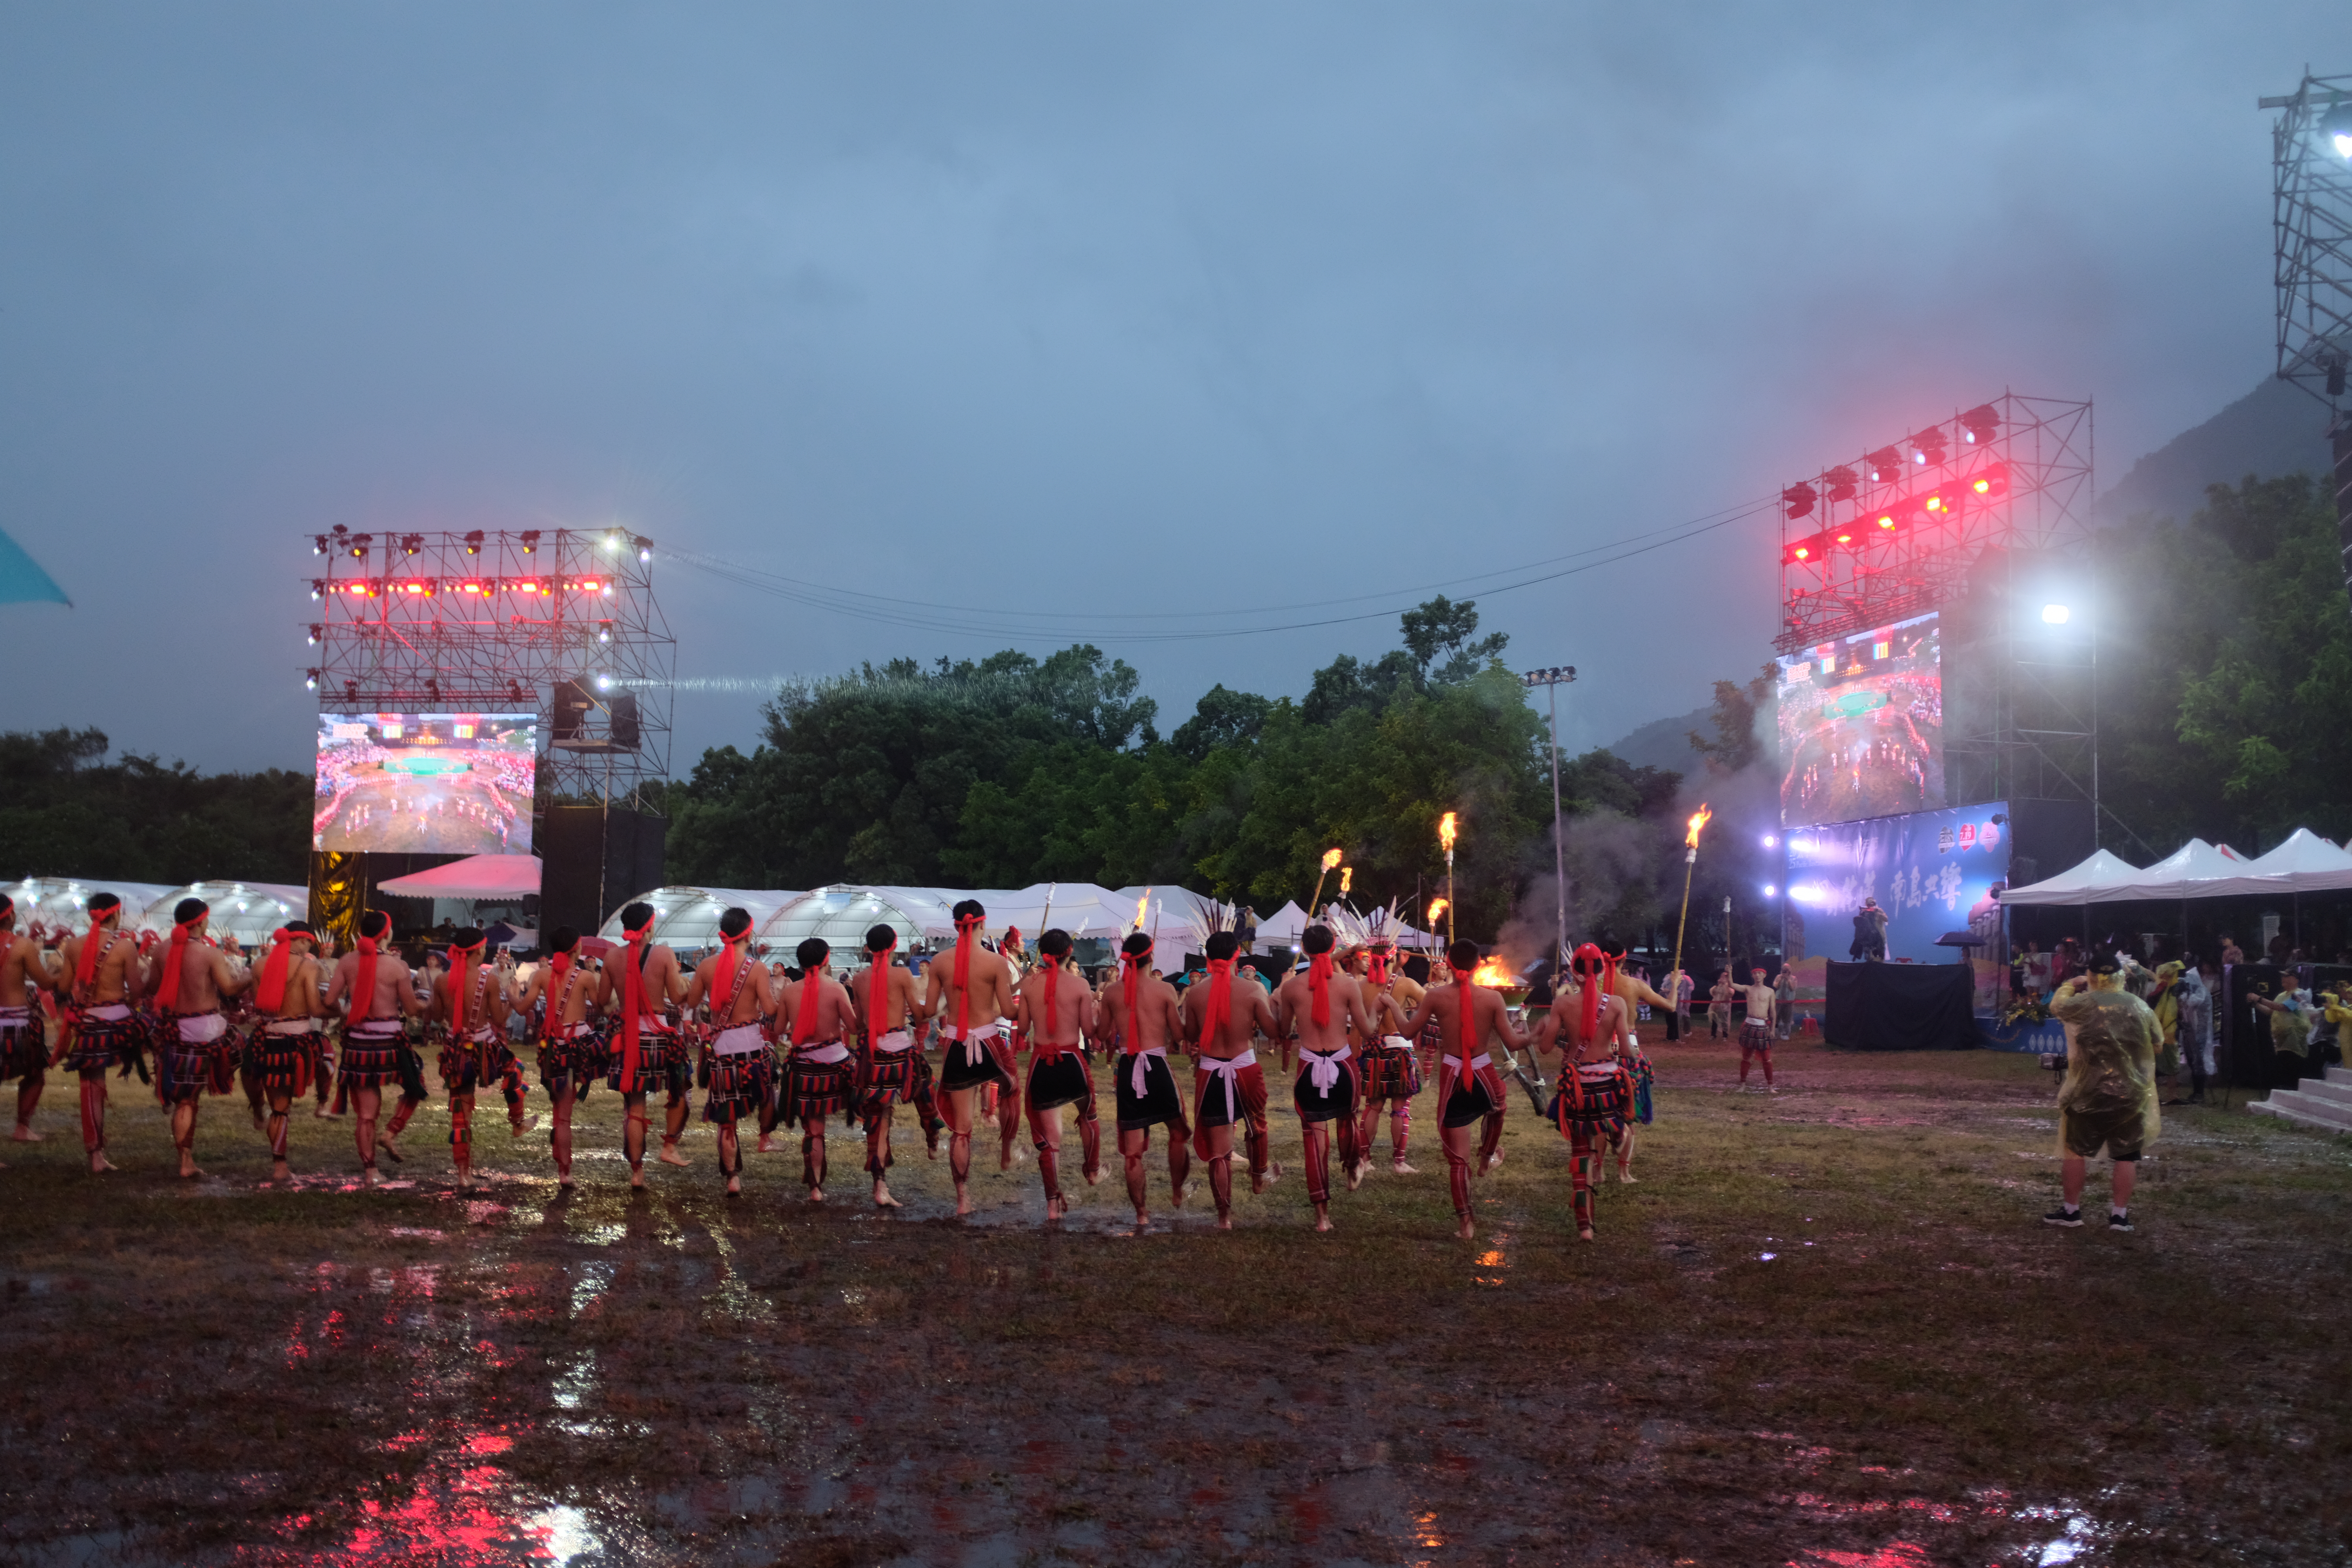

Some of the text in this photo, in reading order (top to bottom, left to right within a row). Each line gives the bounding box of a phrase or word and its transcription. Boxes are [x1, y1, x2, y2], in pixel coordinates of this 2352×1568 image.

[1960, 831, 1971, 840] 7.19
[1890, 862, 1962, 920] 南島共響
